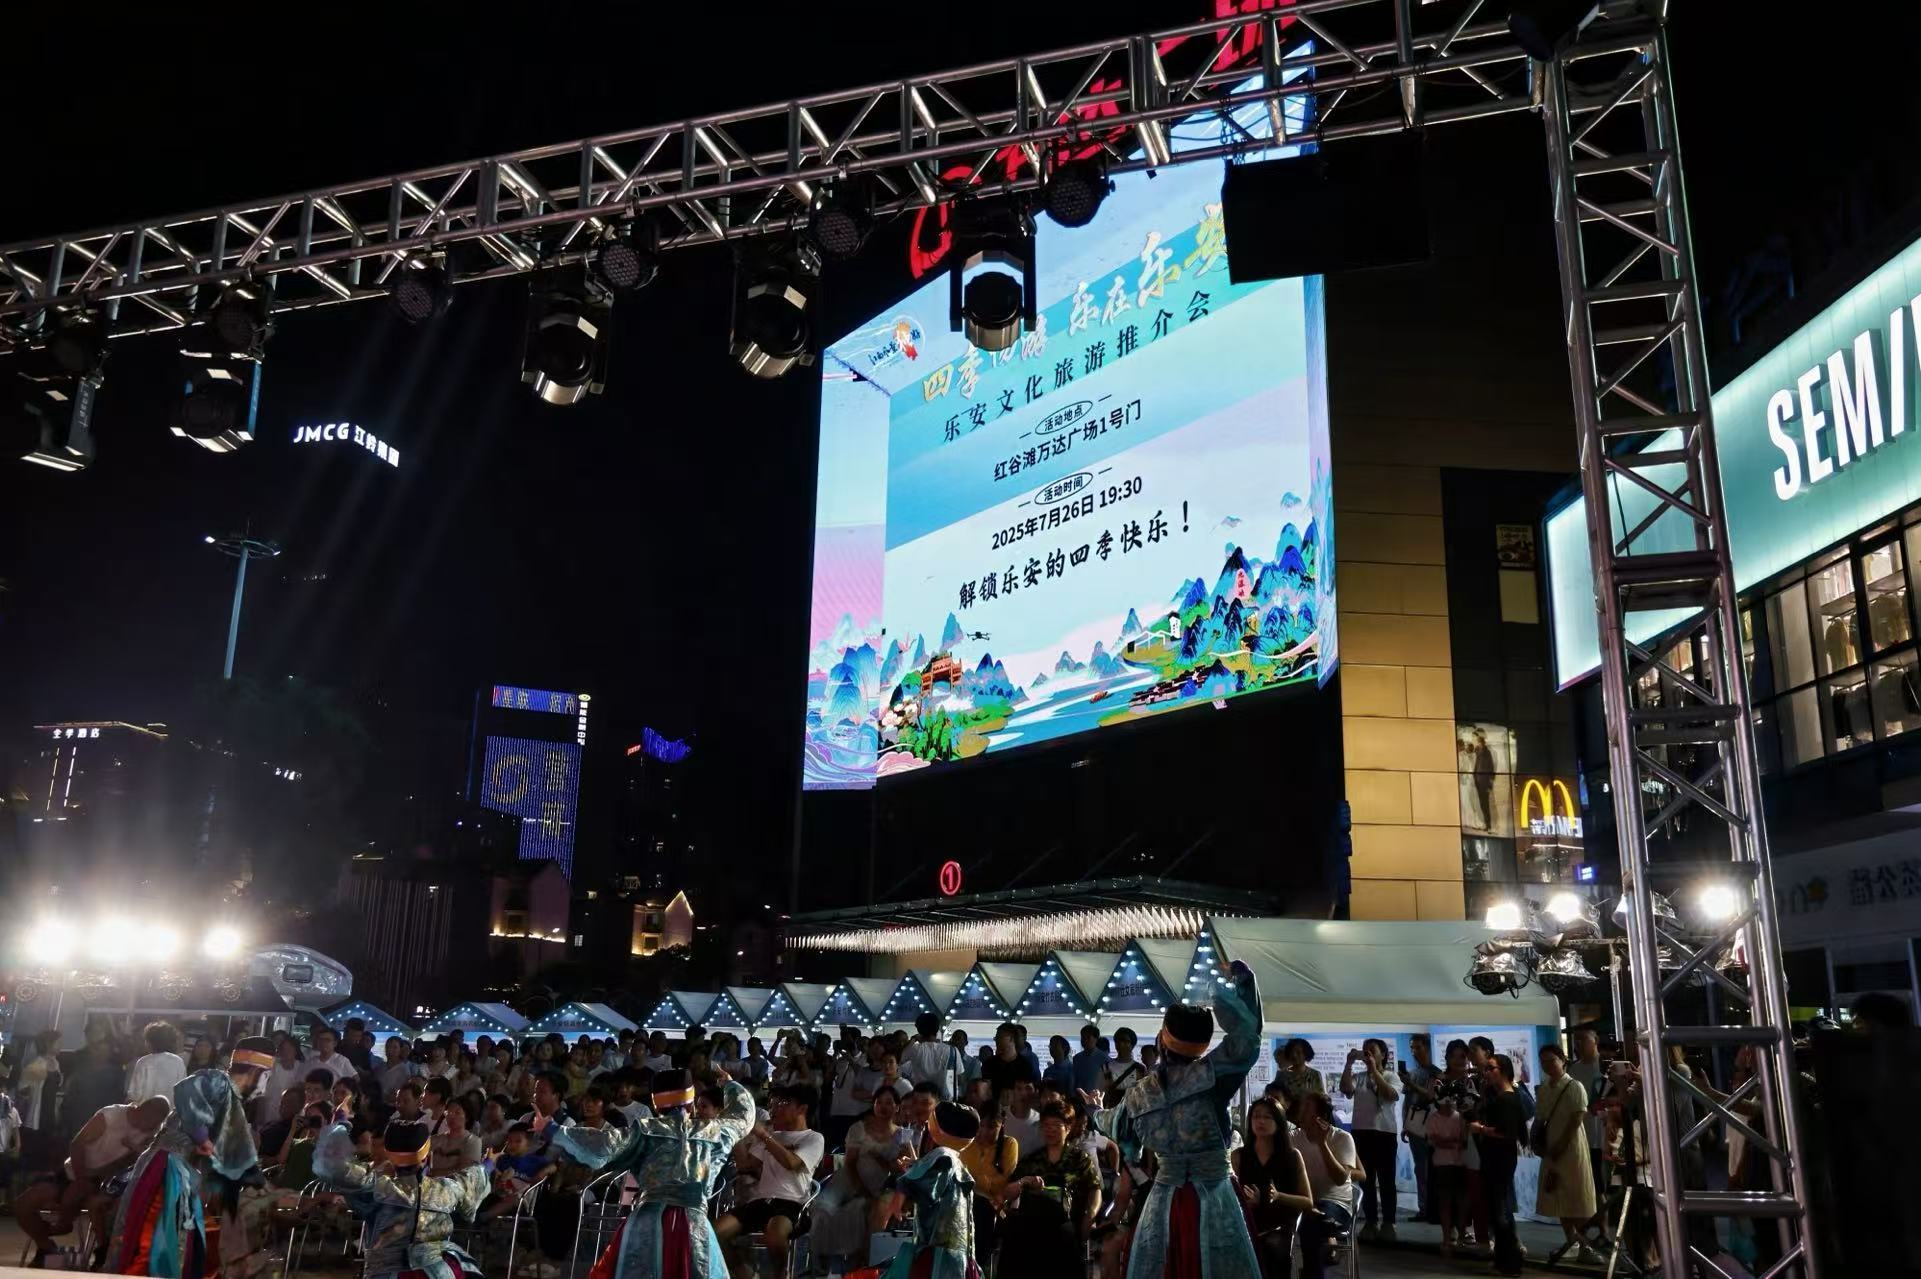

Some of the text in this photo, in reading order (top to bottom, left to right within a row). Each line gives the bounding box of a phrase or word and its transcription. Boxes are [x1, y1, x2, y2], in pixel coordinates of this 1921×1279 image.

[944, 290, 1211, 443] 乐安文化旅游推介会
[1767, 293, 1921, 501] SEMI
[293, 422, 350, 443] JMCG
[994, 399, 1142, 482] 红谷滩万达广场1号门
[1044, 404, 1083, 432] 活动地点
[992, 476, 1142, 550] 2025年7月26日 19:30
[1043, 476, 1083, 502] 活动时间
